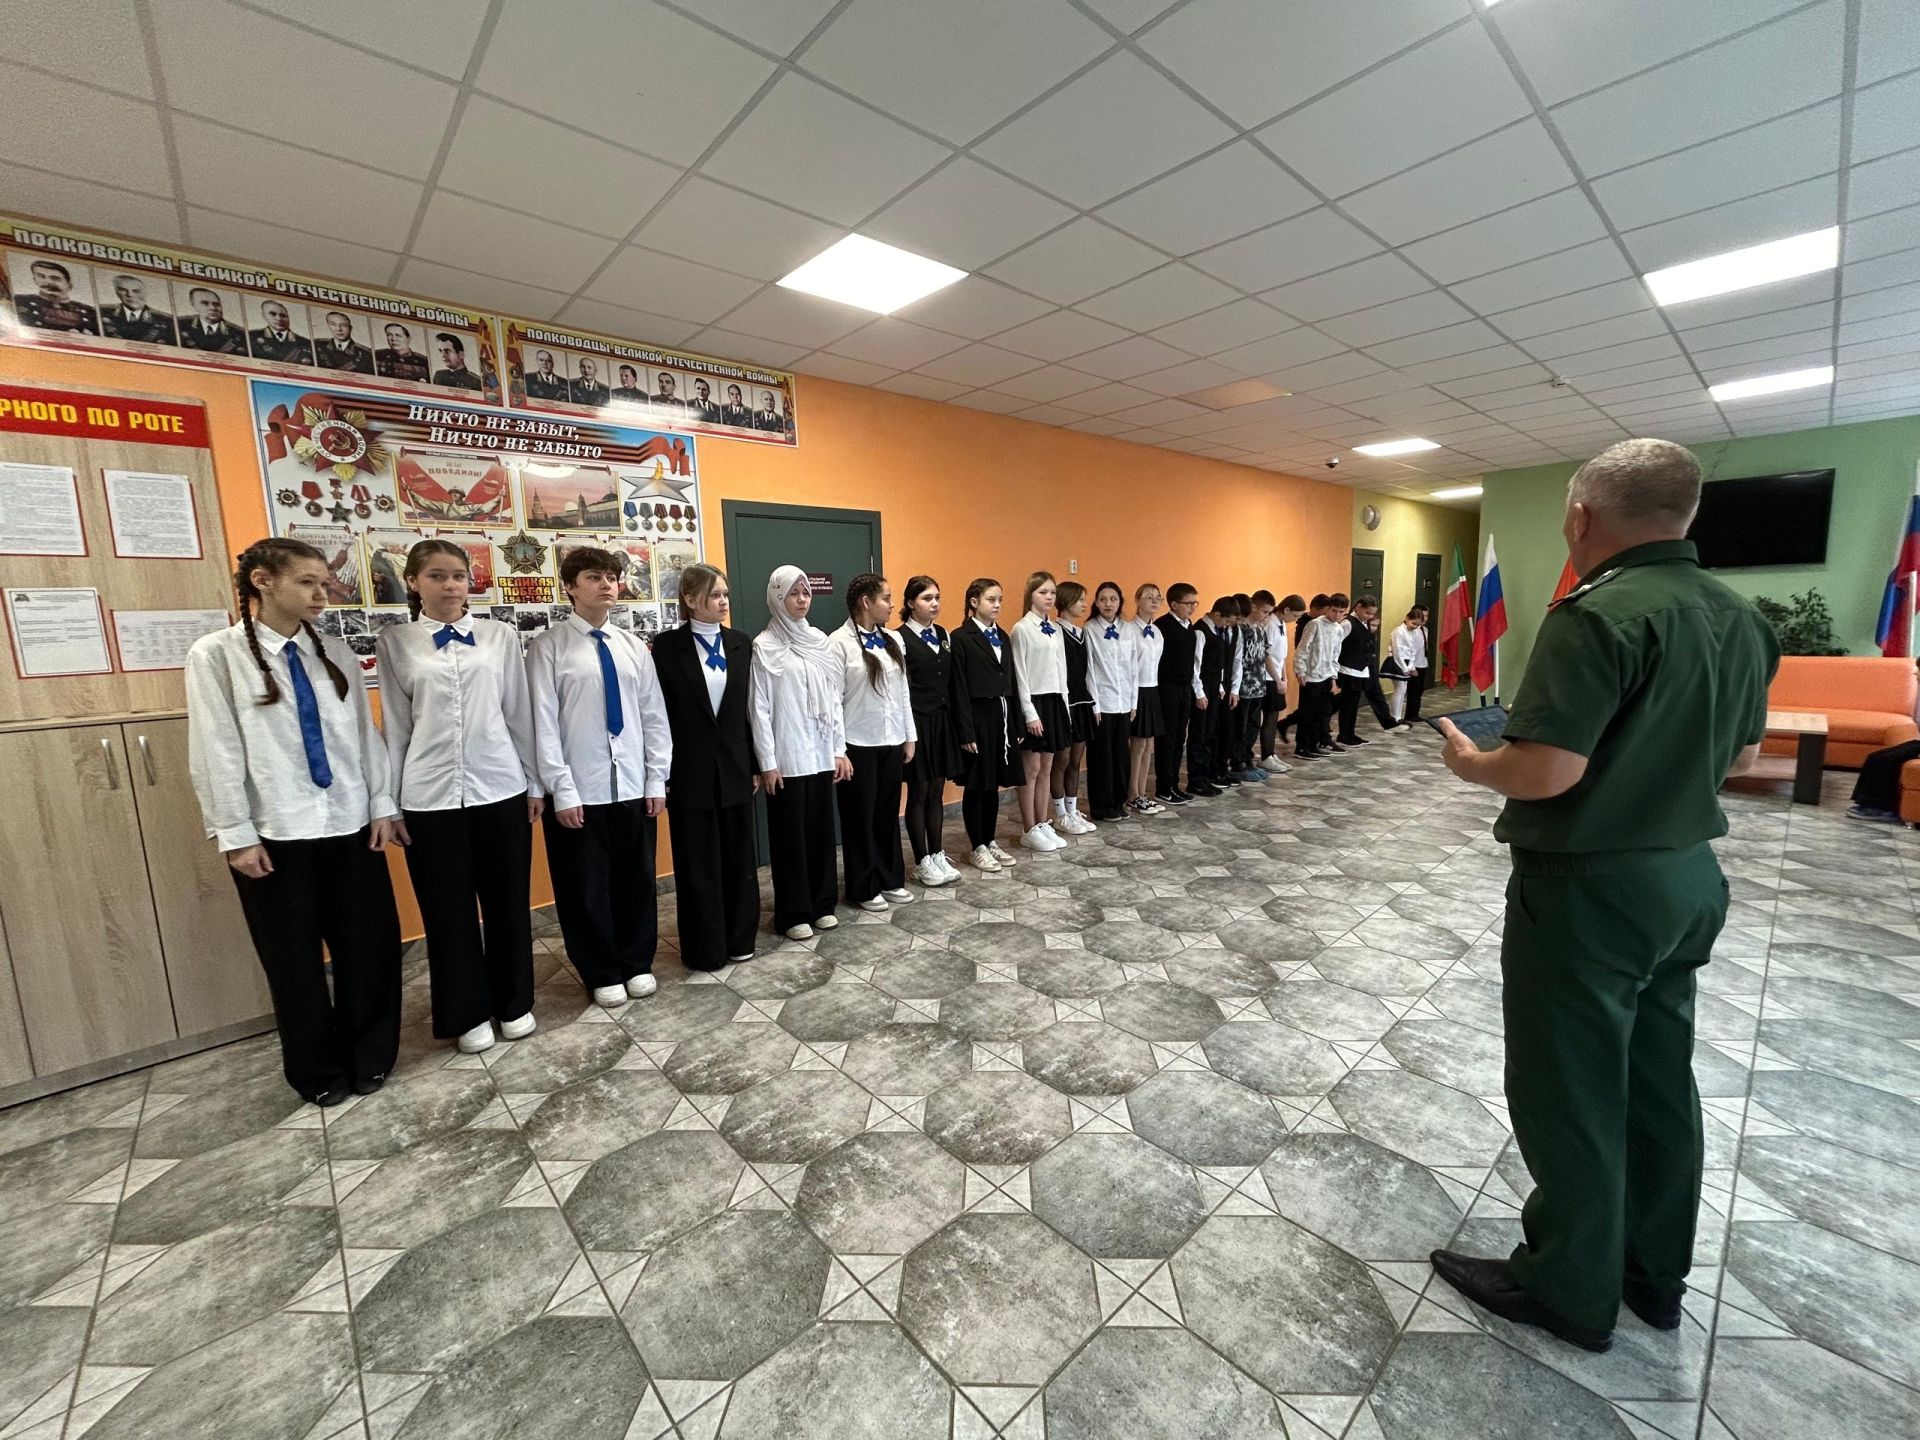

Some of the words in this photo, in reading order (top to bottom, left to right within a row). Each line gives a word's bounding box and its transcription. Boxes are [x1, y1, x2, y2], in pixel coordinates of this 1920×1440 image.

[12, 227, 174, 271] ПОЛКОВОДЦЫ
[179, 258, 268, 288] ВЕЛИКОЙ
[274, 278, 411, 317] ОТЕЧЕСТВЕННОЙ
[415, 305, 469, 327] ВОЙНЫ
[526, 327, 610, 353] ПОЛКОВОДЦЫ
[614, 345, 663, 363] ВЕЛИКОЙ
[666, 355, 744, 378] ОТЕЧЕСТВЕННОЙ
[746, 370, 778, 385] ВОЙНЫ
[86, 407, 120, 427] ПО
[128, 411, 185, 433] РОТЕ
[407, 404, 480, 427] НИКТО
[486, 415, 510, 431] НЕ
[428, 426, 499, 449] НИЧТО
[503, 436, 528, 452] НЕ
[533, 440, 602, 459] ЗАБЫТО
[497, 577, 555, 588] ВЕЛИКАЯ
[503, 587, 553, 597] ПОБЕДА
[503, 595, 553, 604] 1941-1945
